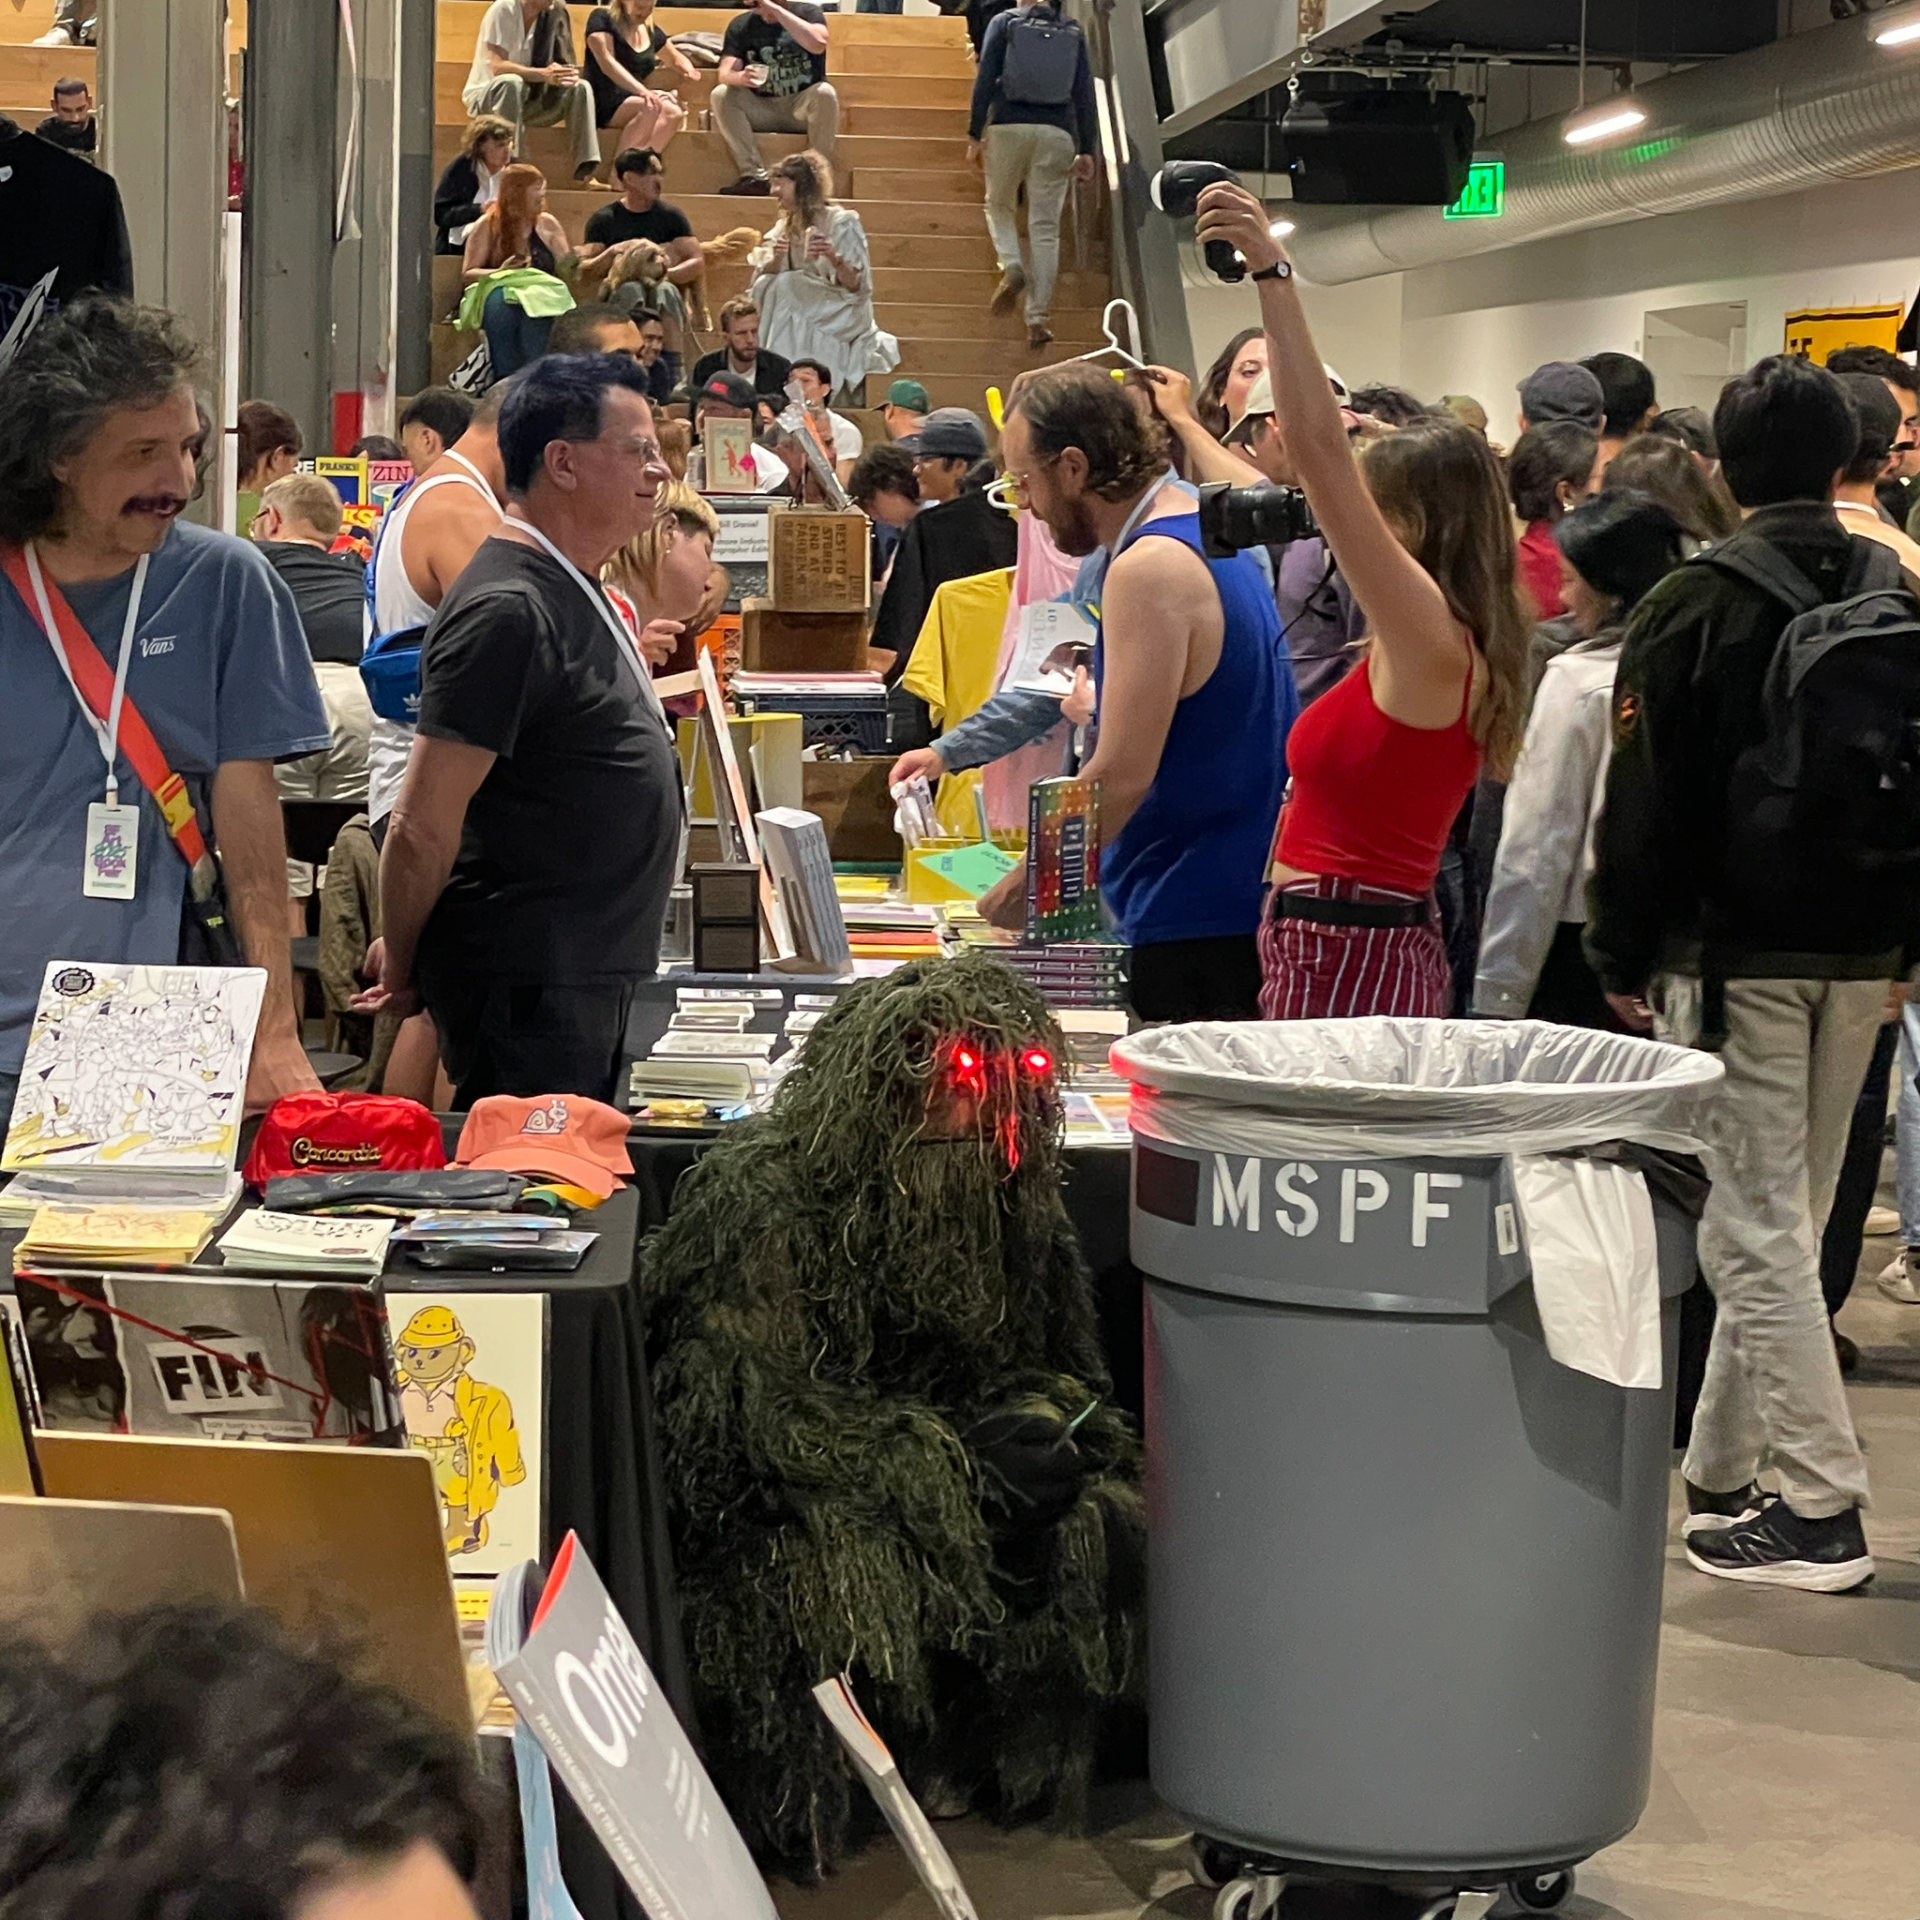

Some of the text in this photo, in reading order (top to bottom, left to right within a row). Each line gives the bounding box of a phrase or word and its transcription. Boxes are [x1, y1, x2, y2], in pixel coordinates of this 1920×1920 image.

[809, 525, 820, 550] END
[822, 526, 834, 574] STORED
[835, 523, 847, 553] BEST
[809, 557, 820, 573] AT
[835, 559, 848, 575] TO
[140, 635, 177, 658] Vans
[292, 1137, 383, 1165] Concordia
[1213, 1153, 1462, 1247] MSPF
